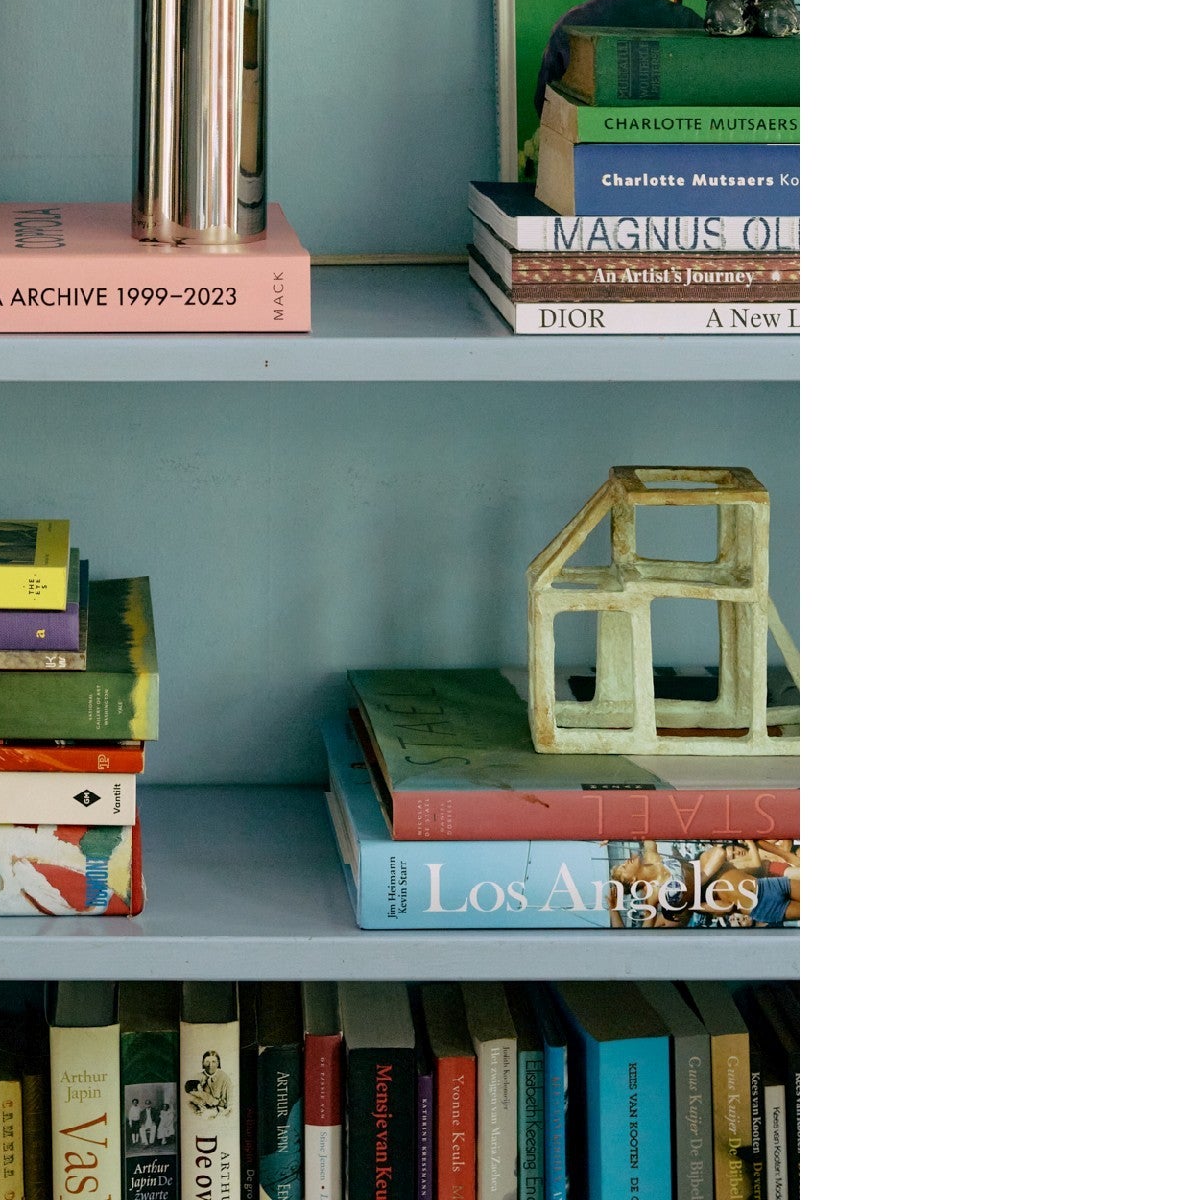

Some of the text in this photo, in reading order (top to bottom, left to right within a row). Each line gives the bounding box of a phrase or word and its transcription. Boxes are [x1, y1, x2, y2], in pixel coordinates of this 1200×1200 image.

[604, 117, 798, 130] CHARLOTTE MUTSAERS
[601, 173, 774, 186] Charlotte Mutsaers
[553, 216, 726, 250] MAGNUS
[11, 287, 109, 307] ARCHIVE
[117, 287, 237, 306] 1999–2023
[273, 270, 284, 321] MACK
[593, 266, 755, 287] An Artist's Journey
[539, 308, 780, 328] DIOR A New
[113, 783, 121, 814] Vantilt
[388, 856, 398, 919] Jim Heimann
[398, 861, 407, 914] Kevin Starr
[422, 861, 759, 921] Los Angeles
[60, 1071, 108, 1084] Arthur
[65, 1086, 102, 1104] Japin
[277, 1071, 290, 1152] ARTHUR JAPIN
[371, 1064, 392, 1162] Mensje van
[452, 1075, 465, 1172] Yvonne Keuls
[523, 1060, 542, 1170] Elisabeth Keesing
[629, 1062, 638, 1169] KEES VAN KOOTEN
[685, 1056, 702, 1156] Guus Kuijer De
[724, 1056, 741, 1156] Guus Kuijer De
[752, 1072, 761, 1154] Kees Kooten
[134, 1162, 170, 1175] Arthur
[196, 1136, 218, 1168] De
[130, 1176, 173, 1191] Japin De
